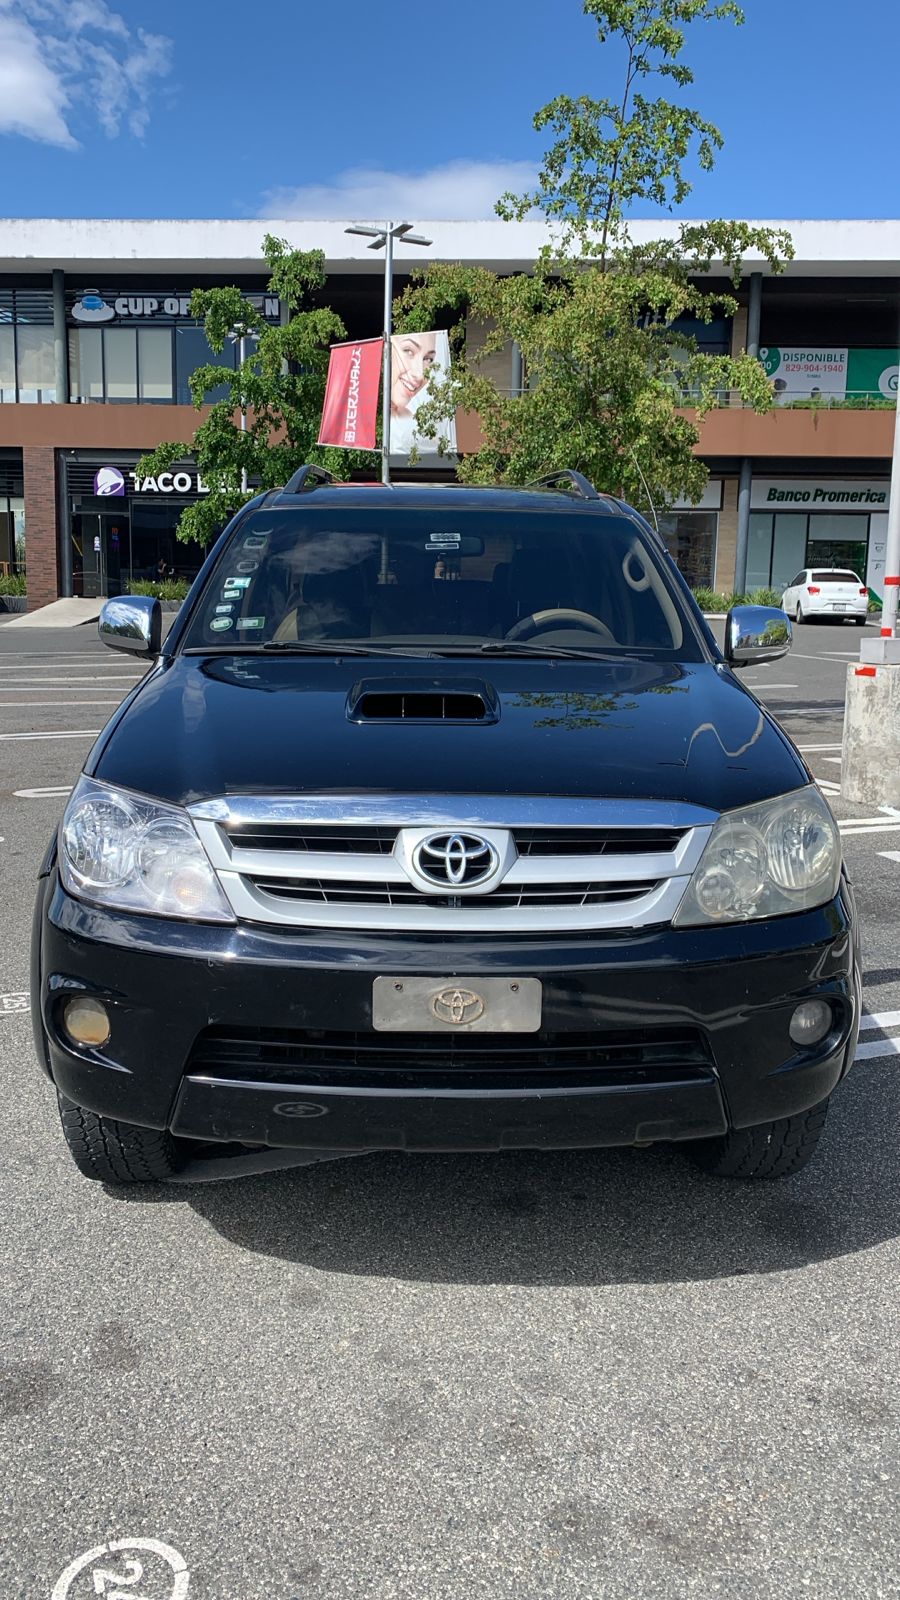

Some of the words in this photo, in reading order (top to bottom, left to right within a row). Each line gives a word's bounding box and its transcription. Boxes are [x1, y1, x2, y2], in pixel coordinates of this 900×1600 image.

[115, 298, 158, 315] CUP
[782, 353, 845, 362] DISPONIBLE
[786, 364, 843, 372] 829-904-1940
[129, 472, 192, 493] TACO
[767, 488, 811, 501] Banco
[814, 489, 886, 503] Promerica
